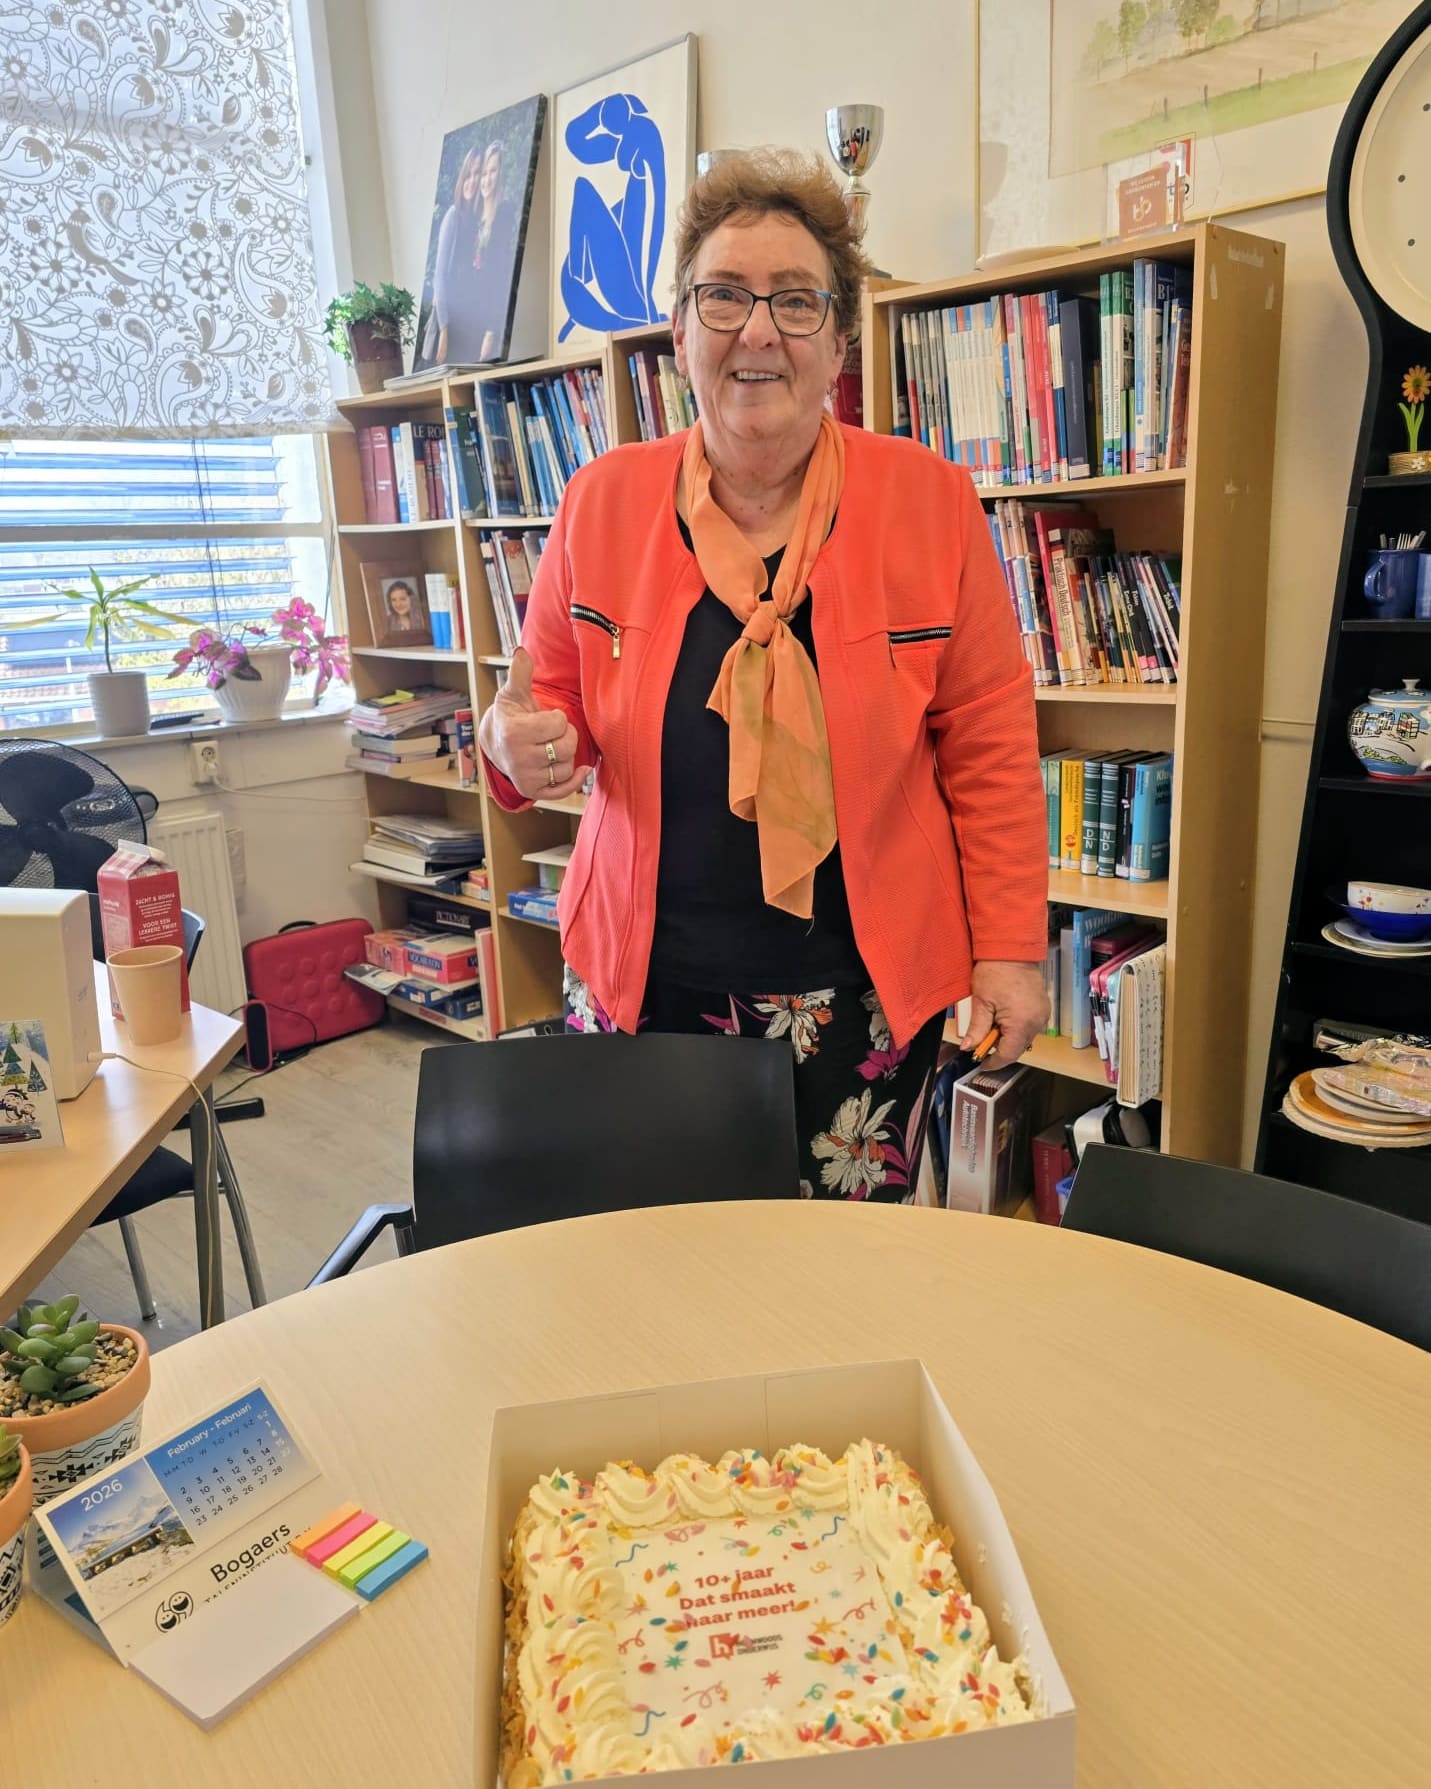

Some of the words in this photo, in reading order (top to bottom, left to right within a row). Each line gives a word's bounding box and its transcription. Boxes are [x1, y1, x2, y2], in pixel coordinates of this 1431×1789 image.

[427, 425, 445, 438] RO
[1085, 841, 1093, 849] N
[1086, 829, 1094, 838] D
[1102, 842, 1110, 851] D
[1103, 831, 1111, 840] N
[167, 1429, 209, 1458] February
[214, 1404, 252, 1429] Februari
[180, 1487, 187, 1495] 2
[256, 1438, 262, 1446] 7
[200, 1486, 211, 1495] 10
[216, 1476, 225, 1484] 11
[231, 1466, 241, 1475] 12
[247, 1456, 257, 1465] 13
[261, 1448, 271, 1456] 14
[81, 1479, 123, 1512] 2026
[190, 1506, 201, 1515] 16
[206, 1496, 216, 1505] 17
[221, 1486, 232, 1495] 18
[236, 1476, 247, 1484] 19
[251, 1465, 264, 1476] 20
[267, 1457, 277, 1466] 21
[195, 1515, 208, 1526] 23
[211, 1505, 223, 1516] 24
[227, 1494, 239, 1505] 25
[242, 1484, 254, 1495] 26
[258, 1474, 268, 1485] 27
[271, 1465, 283, 1476] 28
[210, 1524, 291, 1583] Bogaers
[694, 1574, 731, 1589] 10+
[735, 1567, 775, 1584] jaar
[679, 1594, 716, 1611] Dat
[719, 1582, 797, 1603] smaakt
[737, 1600, 796, 1620] meer!
